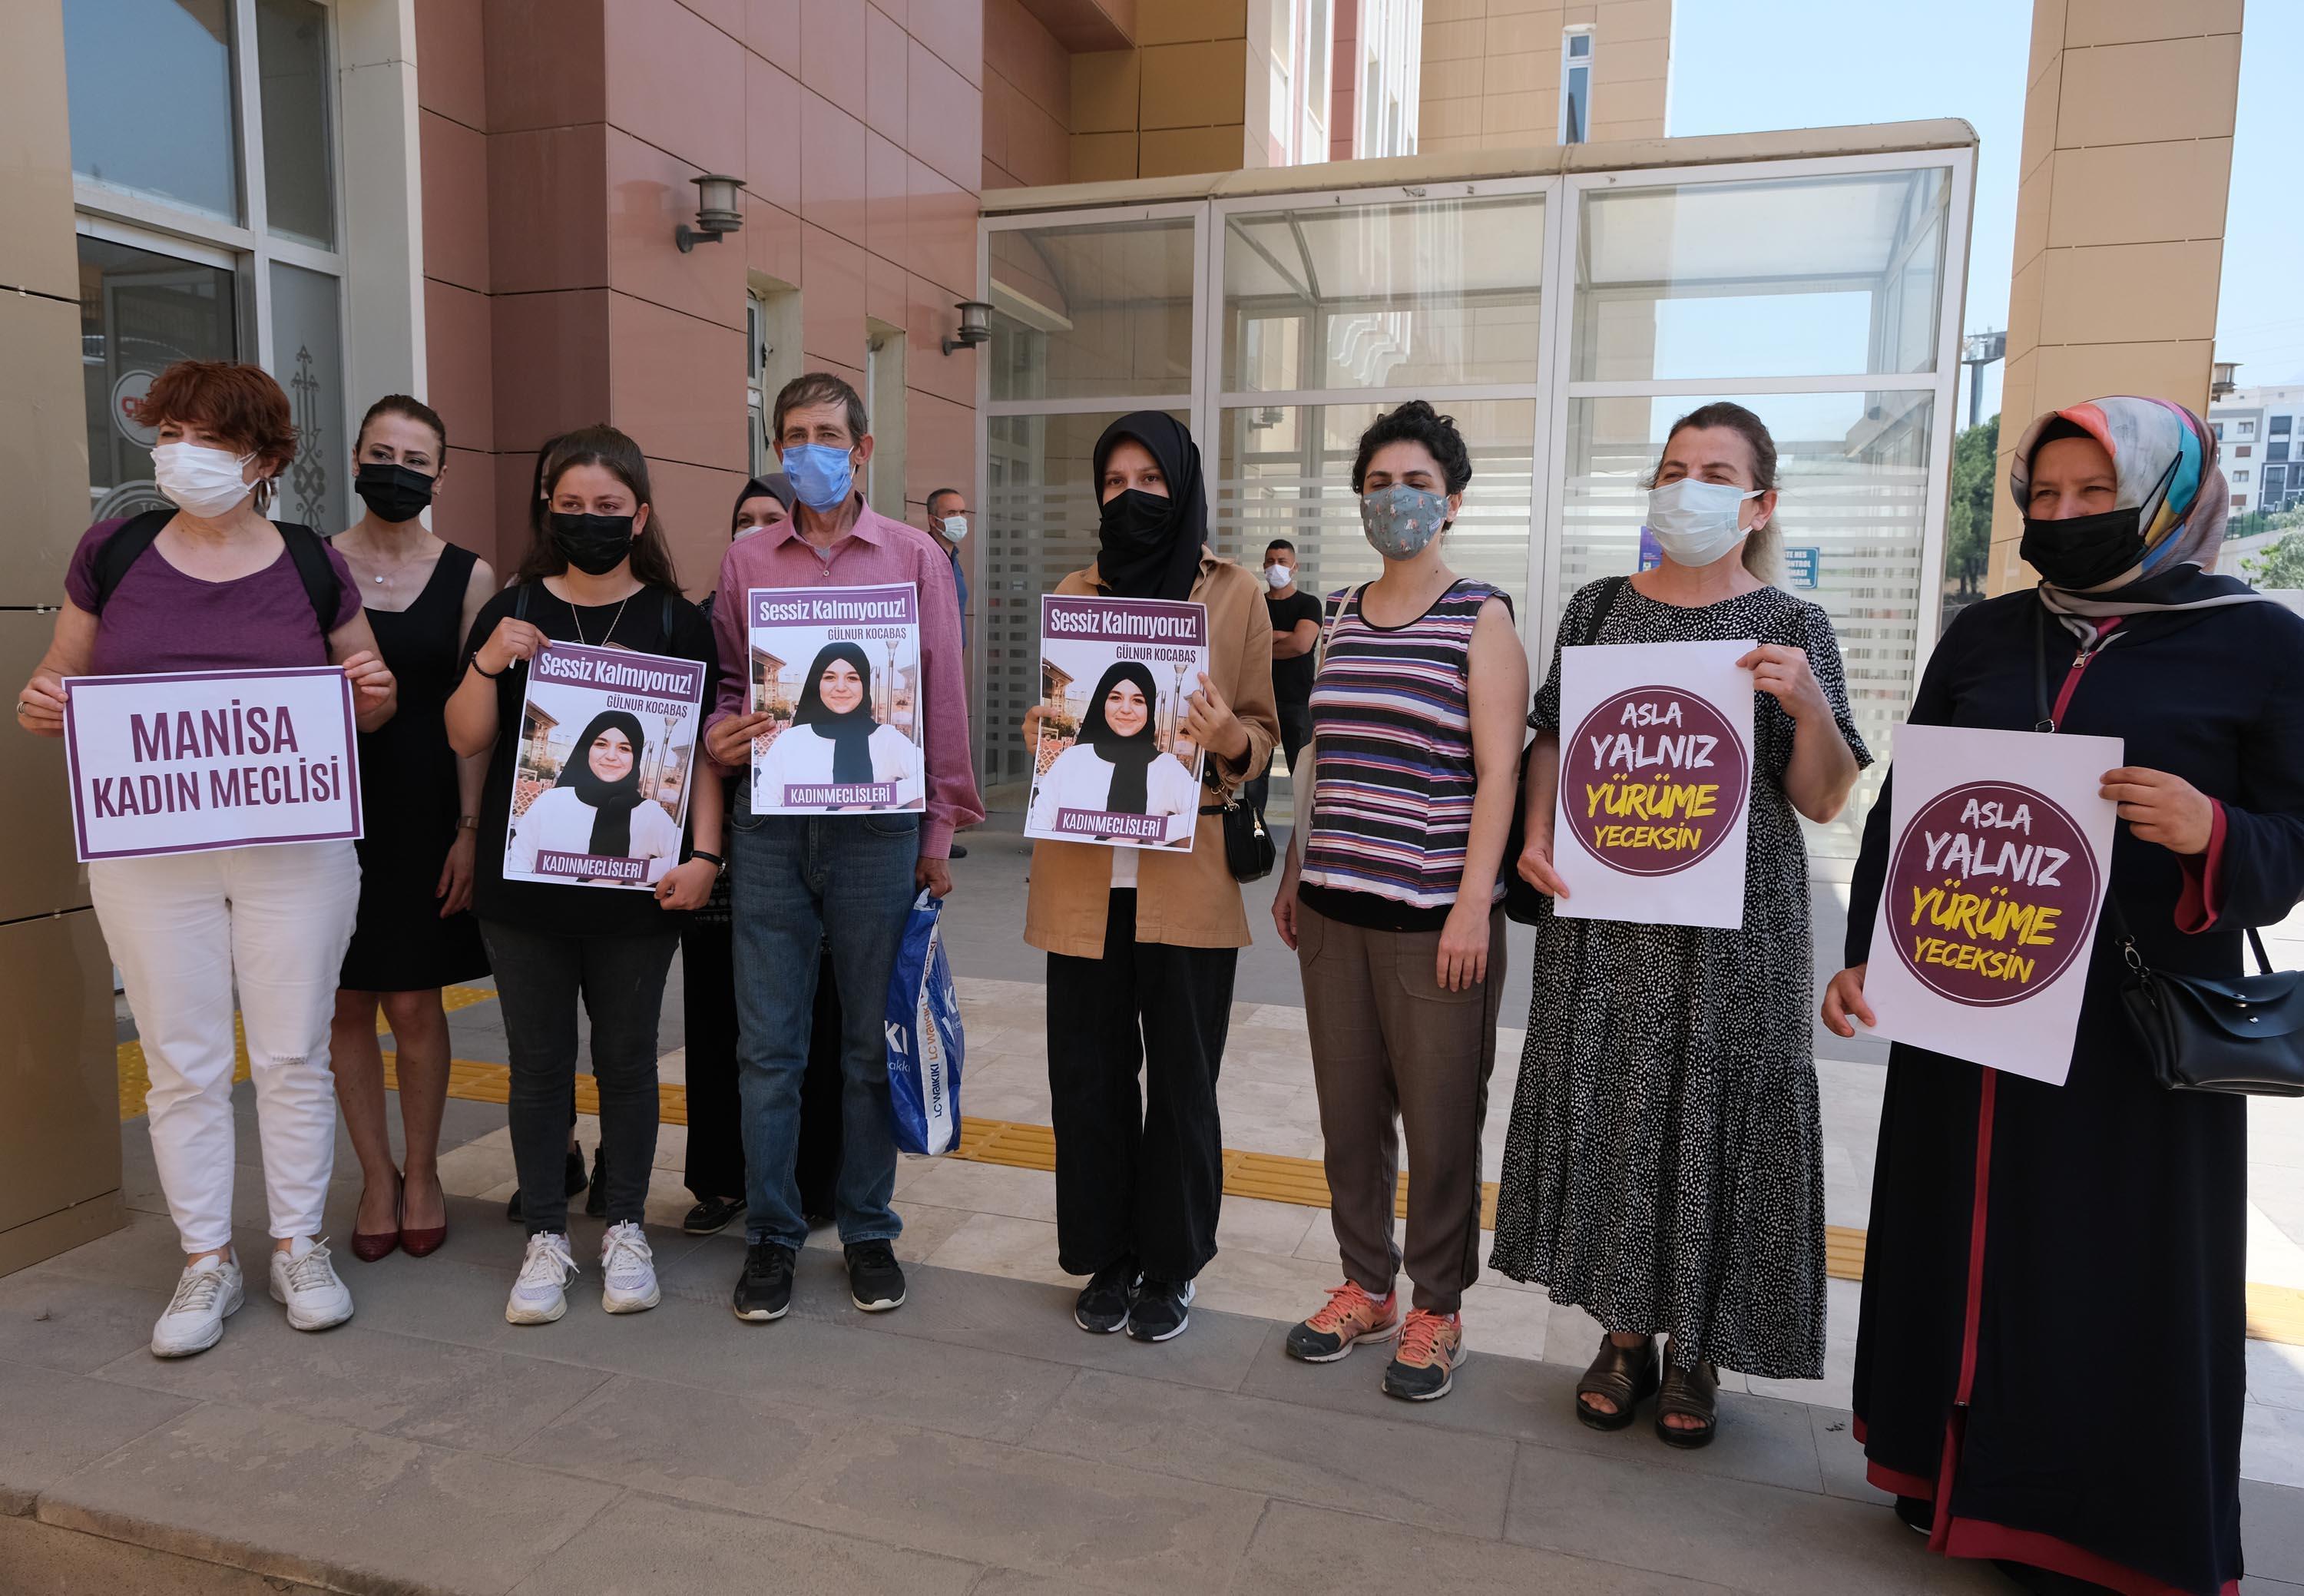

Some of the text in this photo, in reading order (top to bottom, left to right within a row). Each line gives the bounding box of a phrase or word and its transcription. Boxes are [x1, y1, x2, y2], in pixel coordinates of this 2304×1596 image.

[760, 598, 906, 622] Sessiz Kalmıyoruz!
[1051, 608, 1197, 639] Sessiz Kalmıyoruz!
[828, 627, 906, 641] GÜLNUR KOCABAŞ
[1116, 644, 1196, 664] GÜLNUR KOCABAŞ
[540, 652, 693, 694] Sessiz Kalmıyoruz!
[607, 694, 688, 718] GÜLNUR KOCABAŞ
[1620, 701, 1683, 728] ASLA
[130, 699, 299, 763] MANİSA
[1591, 733, 1720, 772] YALNIZ
[92, 755, 340, 818] KADIN MECLİSİ
[791, 785, 890, 803] KADINMECLİSLERİ
[1586, 773, 1720, 821] YÜRÜME
[1062, 813, 1161, 837] KADINMECLİSLERİ
[1960, 798, 2033, 836] ASLA
[1594, 822, 1702, 850] YECEKSİN
[542, 855, 643, 878] KADINMECLİSLERİ
[1924, 830, 2071, 887] YALNIZ
[1910, 878, 2062, 946] YÜRÜME
[1914, 935, 2035, 984] YECEKSİN
